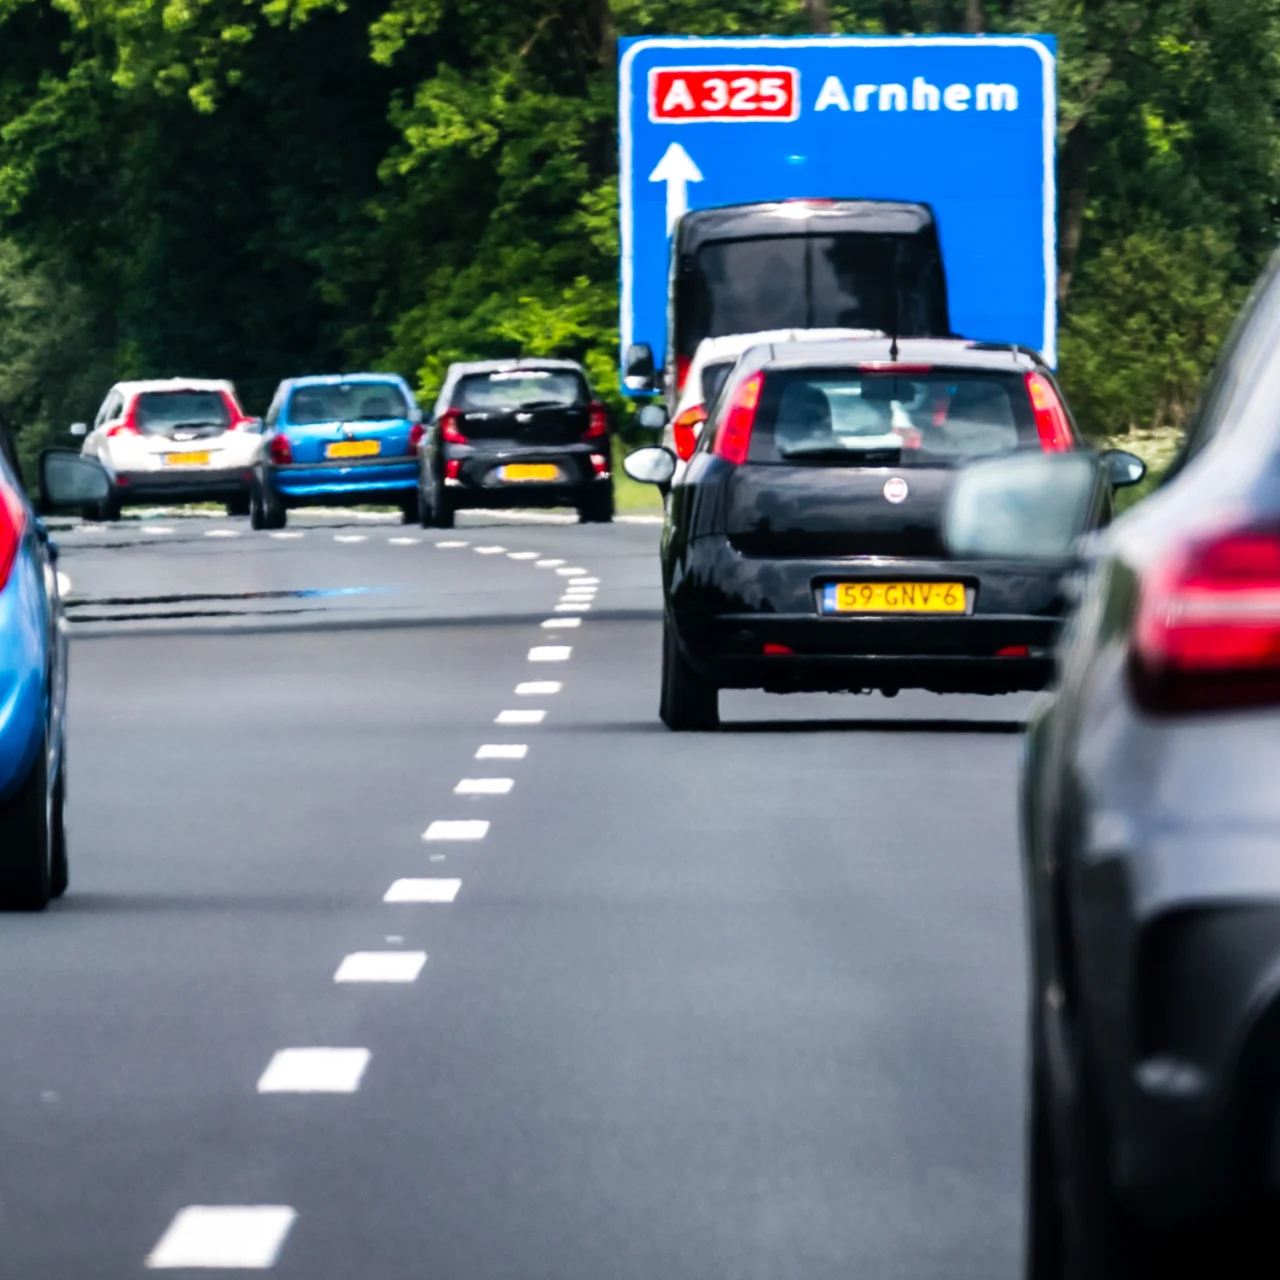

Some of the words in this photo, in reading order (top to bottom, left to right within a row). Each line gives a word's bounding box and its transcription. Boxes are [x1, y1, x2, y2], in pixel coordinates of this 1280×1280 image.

[661, 77, 789, 111] A325
[814, 75, 1019, 112] Arnhem
[843, 585, 958, 606] 59-GNV-6
